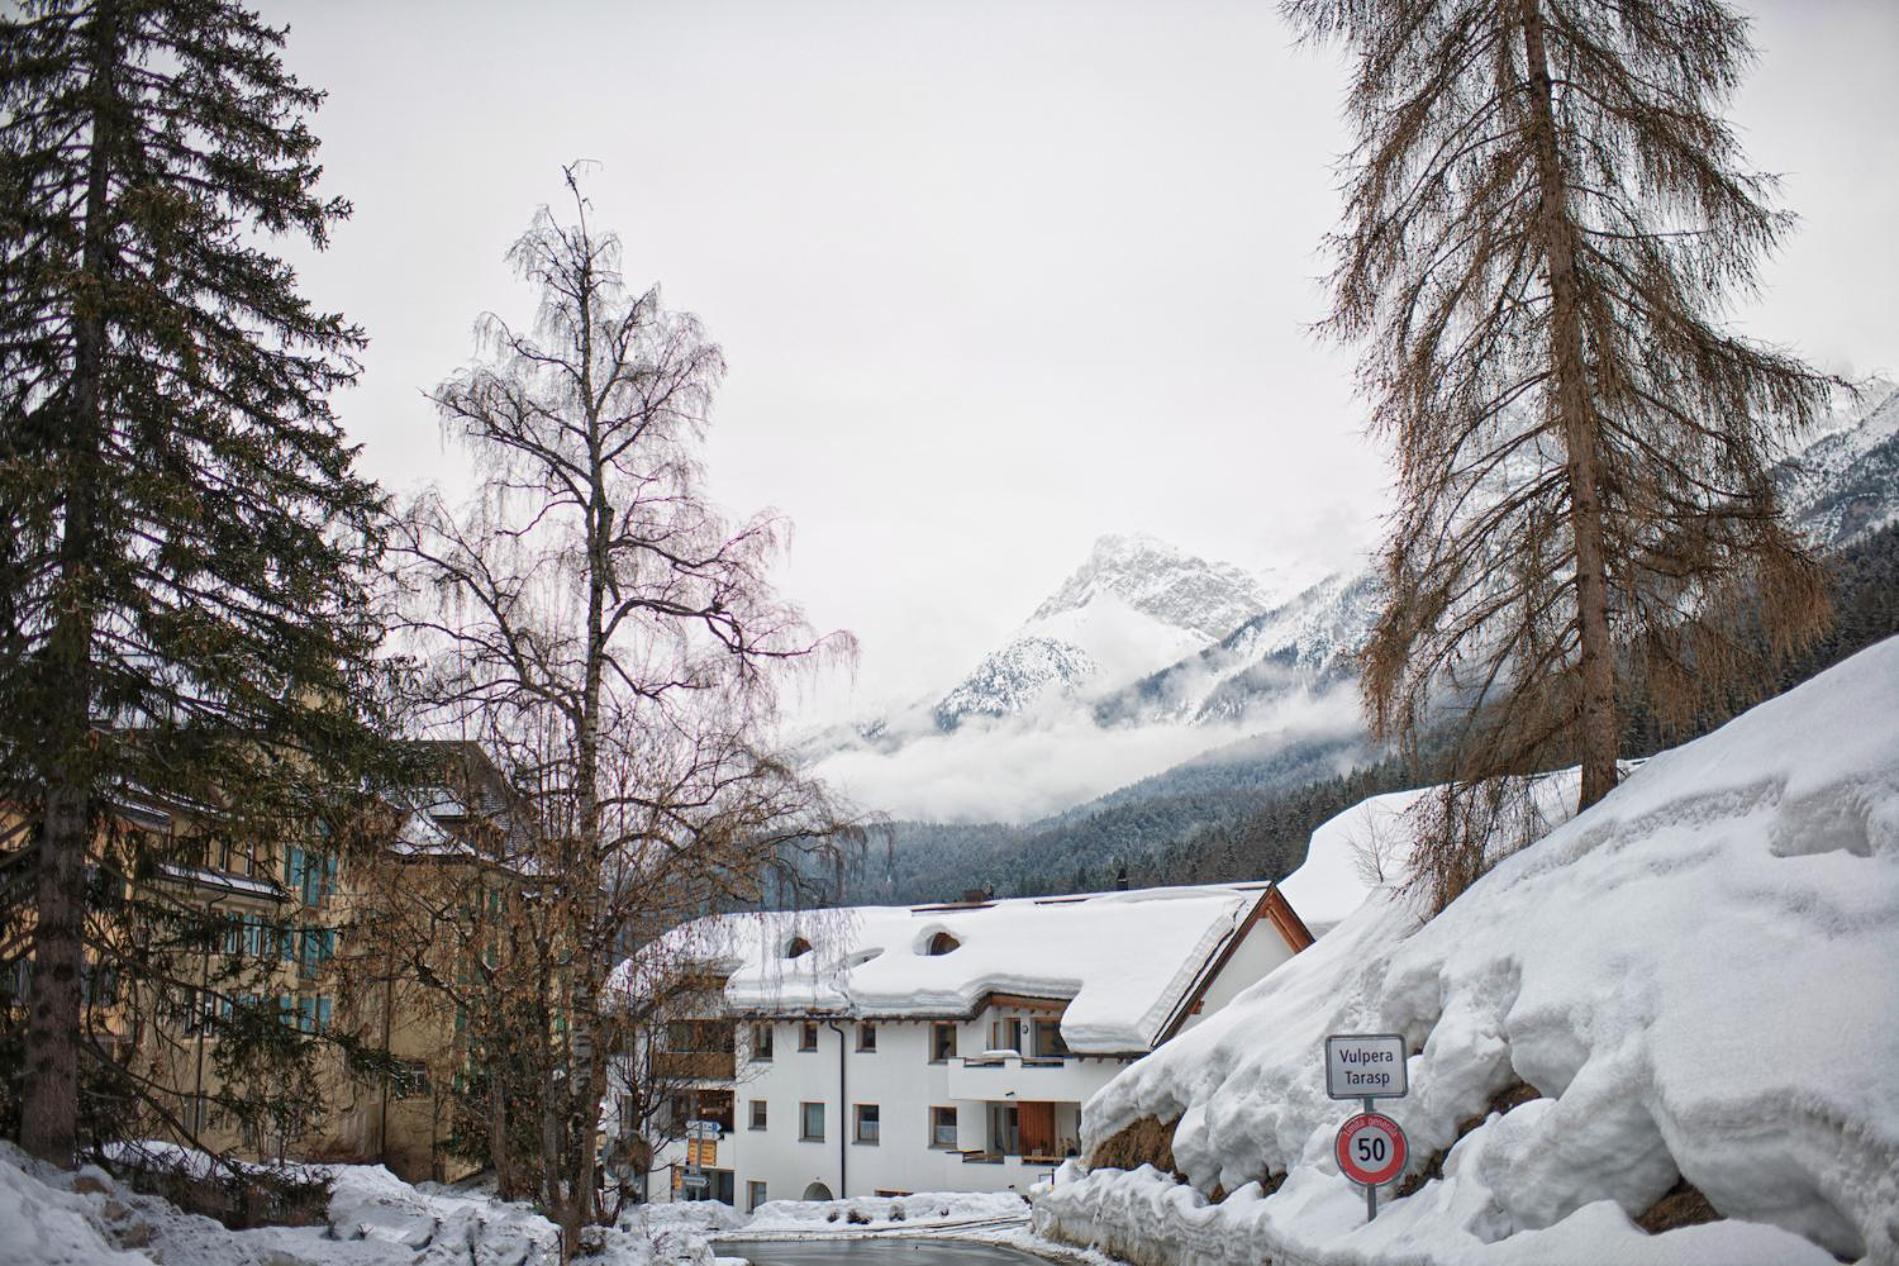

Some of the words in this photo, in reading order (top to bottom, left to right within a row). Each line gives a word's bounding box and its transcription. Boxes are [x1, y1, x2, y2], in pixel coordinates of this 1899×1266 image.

[1339, 1048, 1393, 1066] Vulpera
[1345, 1071, 1390, 1087] Tarasp
[1359, 1137, 1385, 1162] 50
